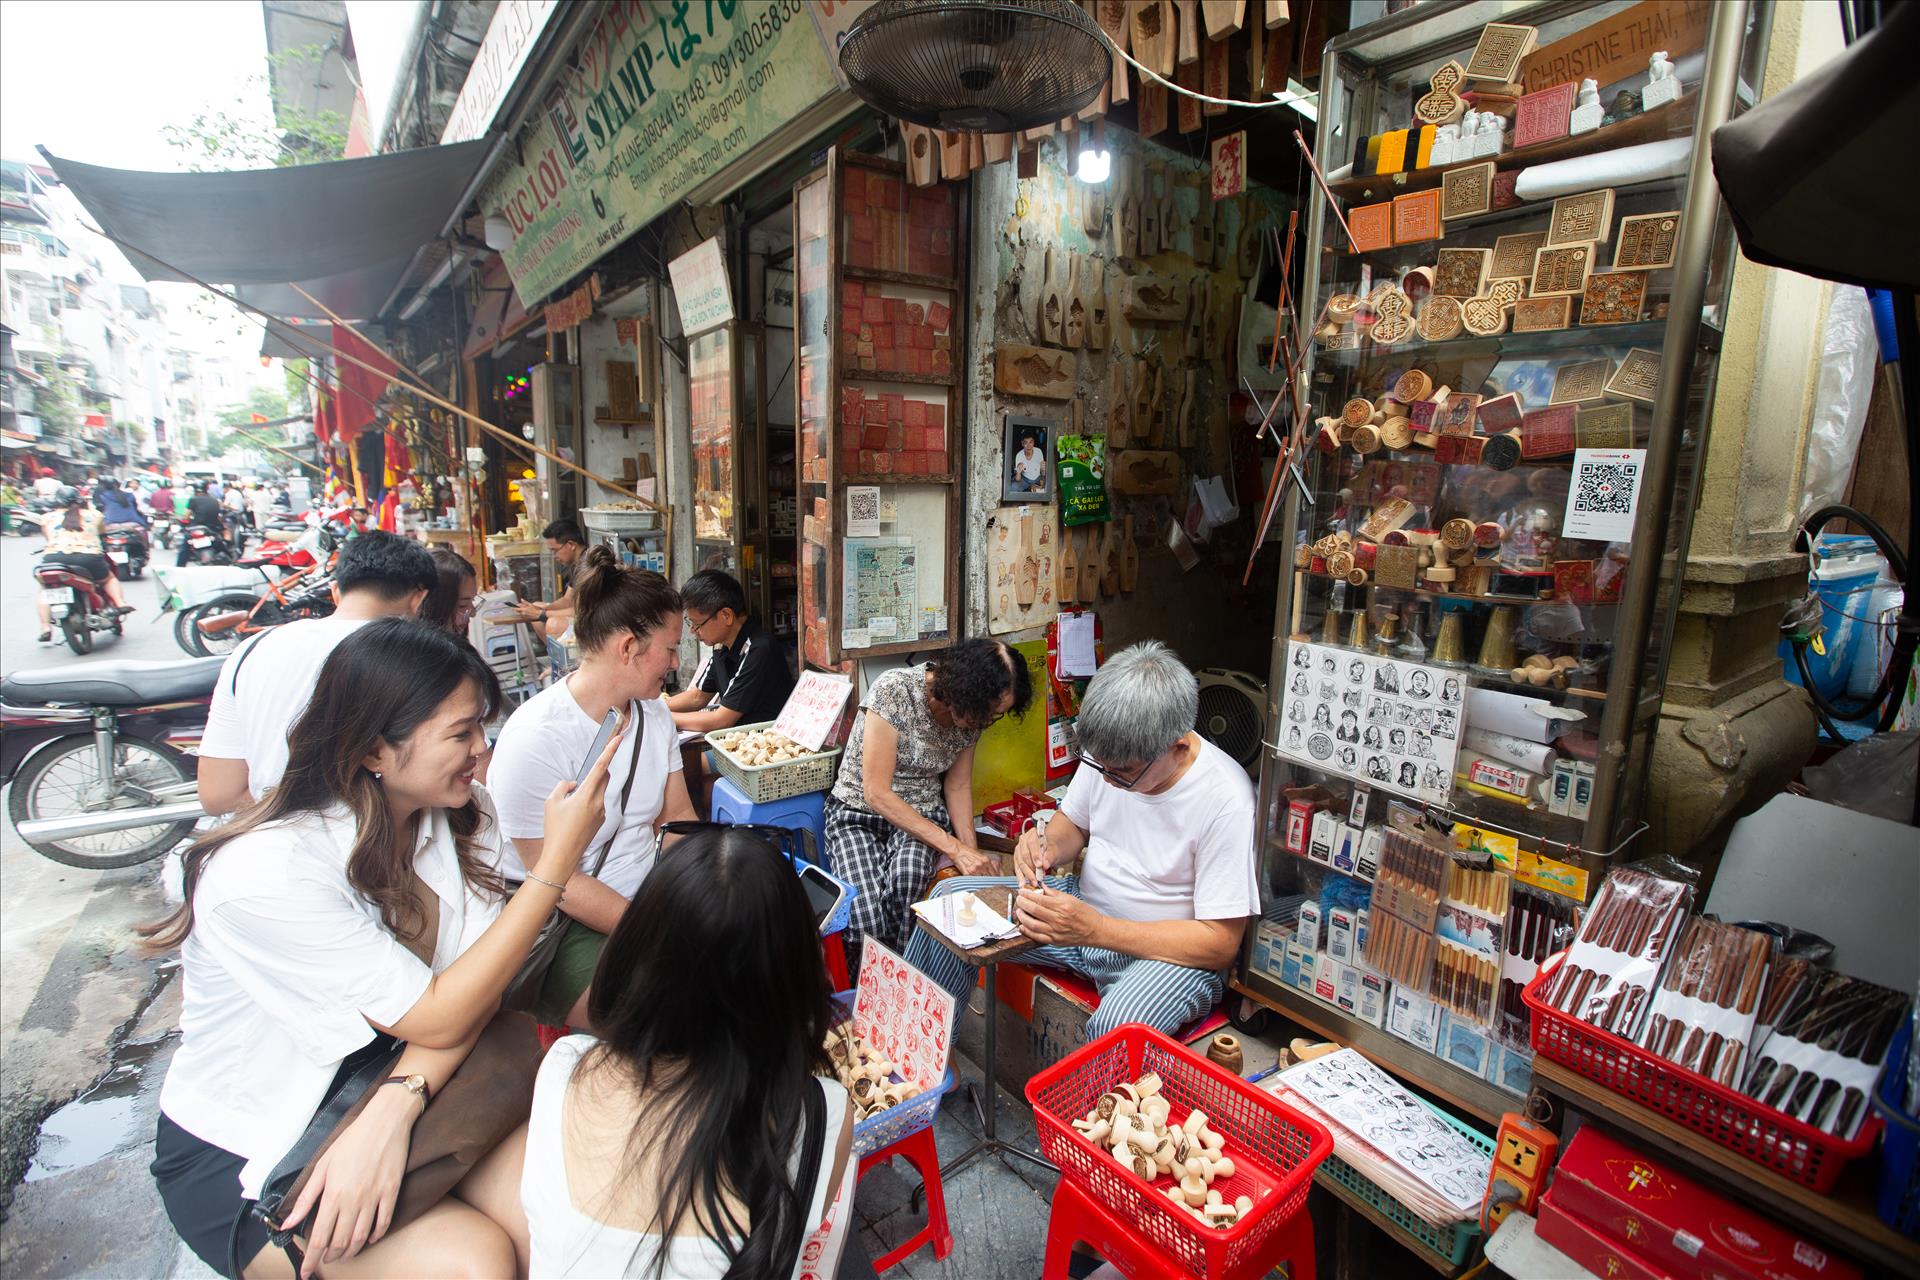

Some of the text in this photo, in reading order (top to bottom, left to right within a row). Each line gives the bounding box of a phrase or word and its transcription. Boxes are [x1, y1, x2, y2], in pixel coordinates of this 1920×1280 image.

[604, 154, 623, 184] HOT
[591, 188, 606, 220] 6
[1053, 735, 1060, 743] 27
